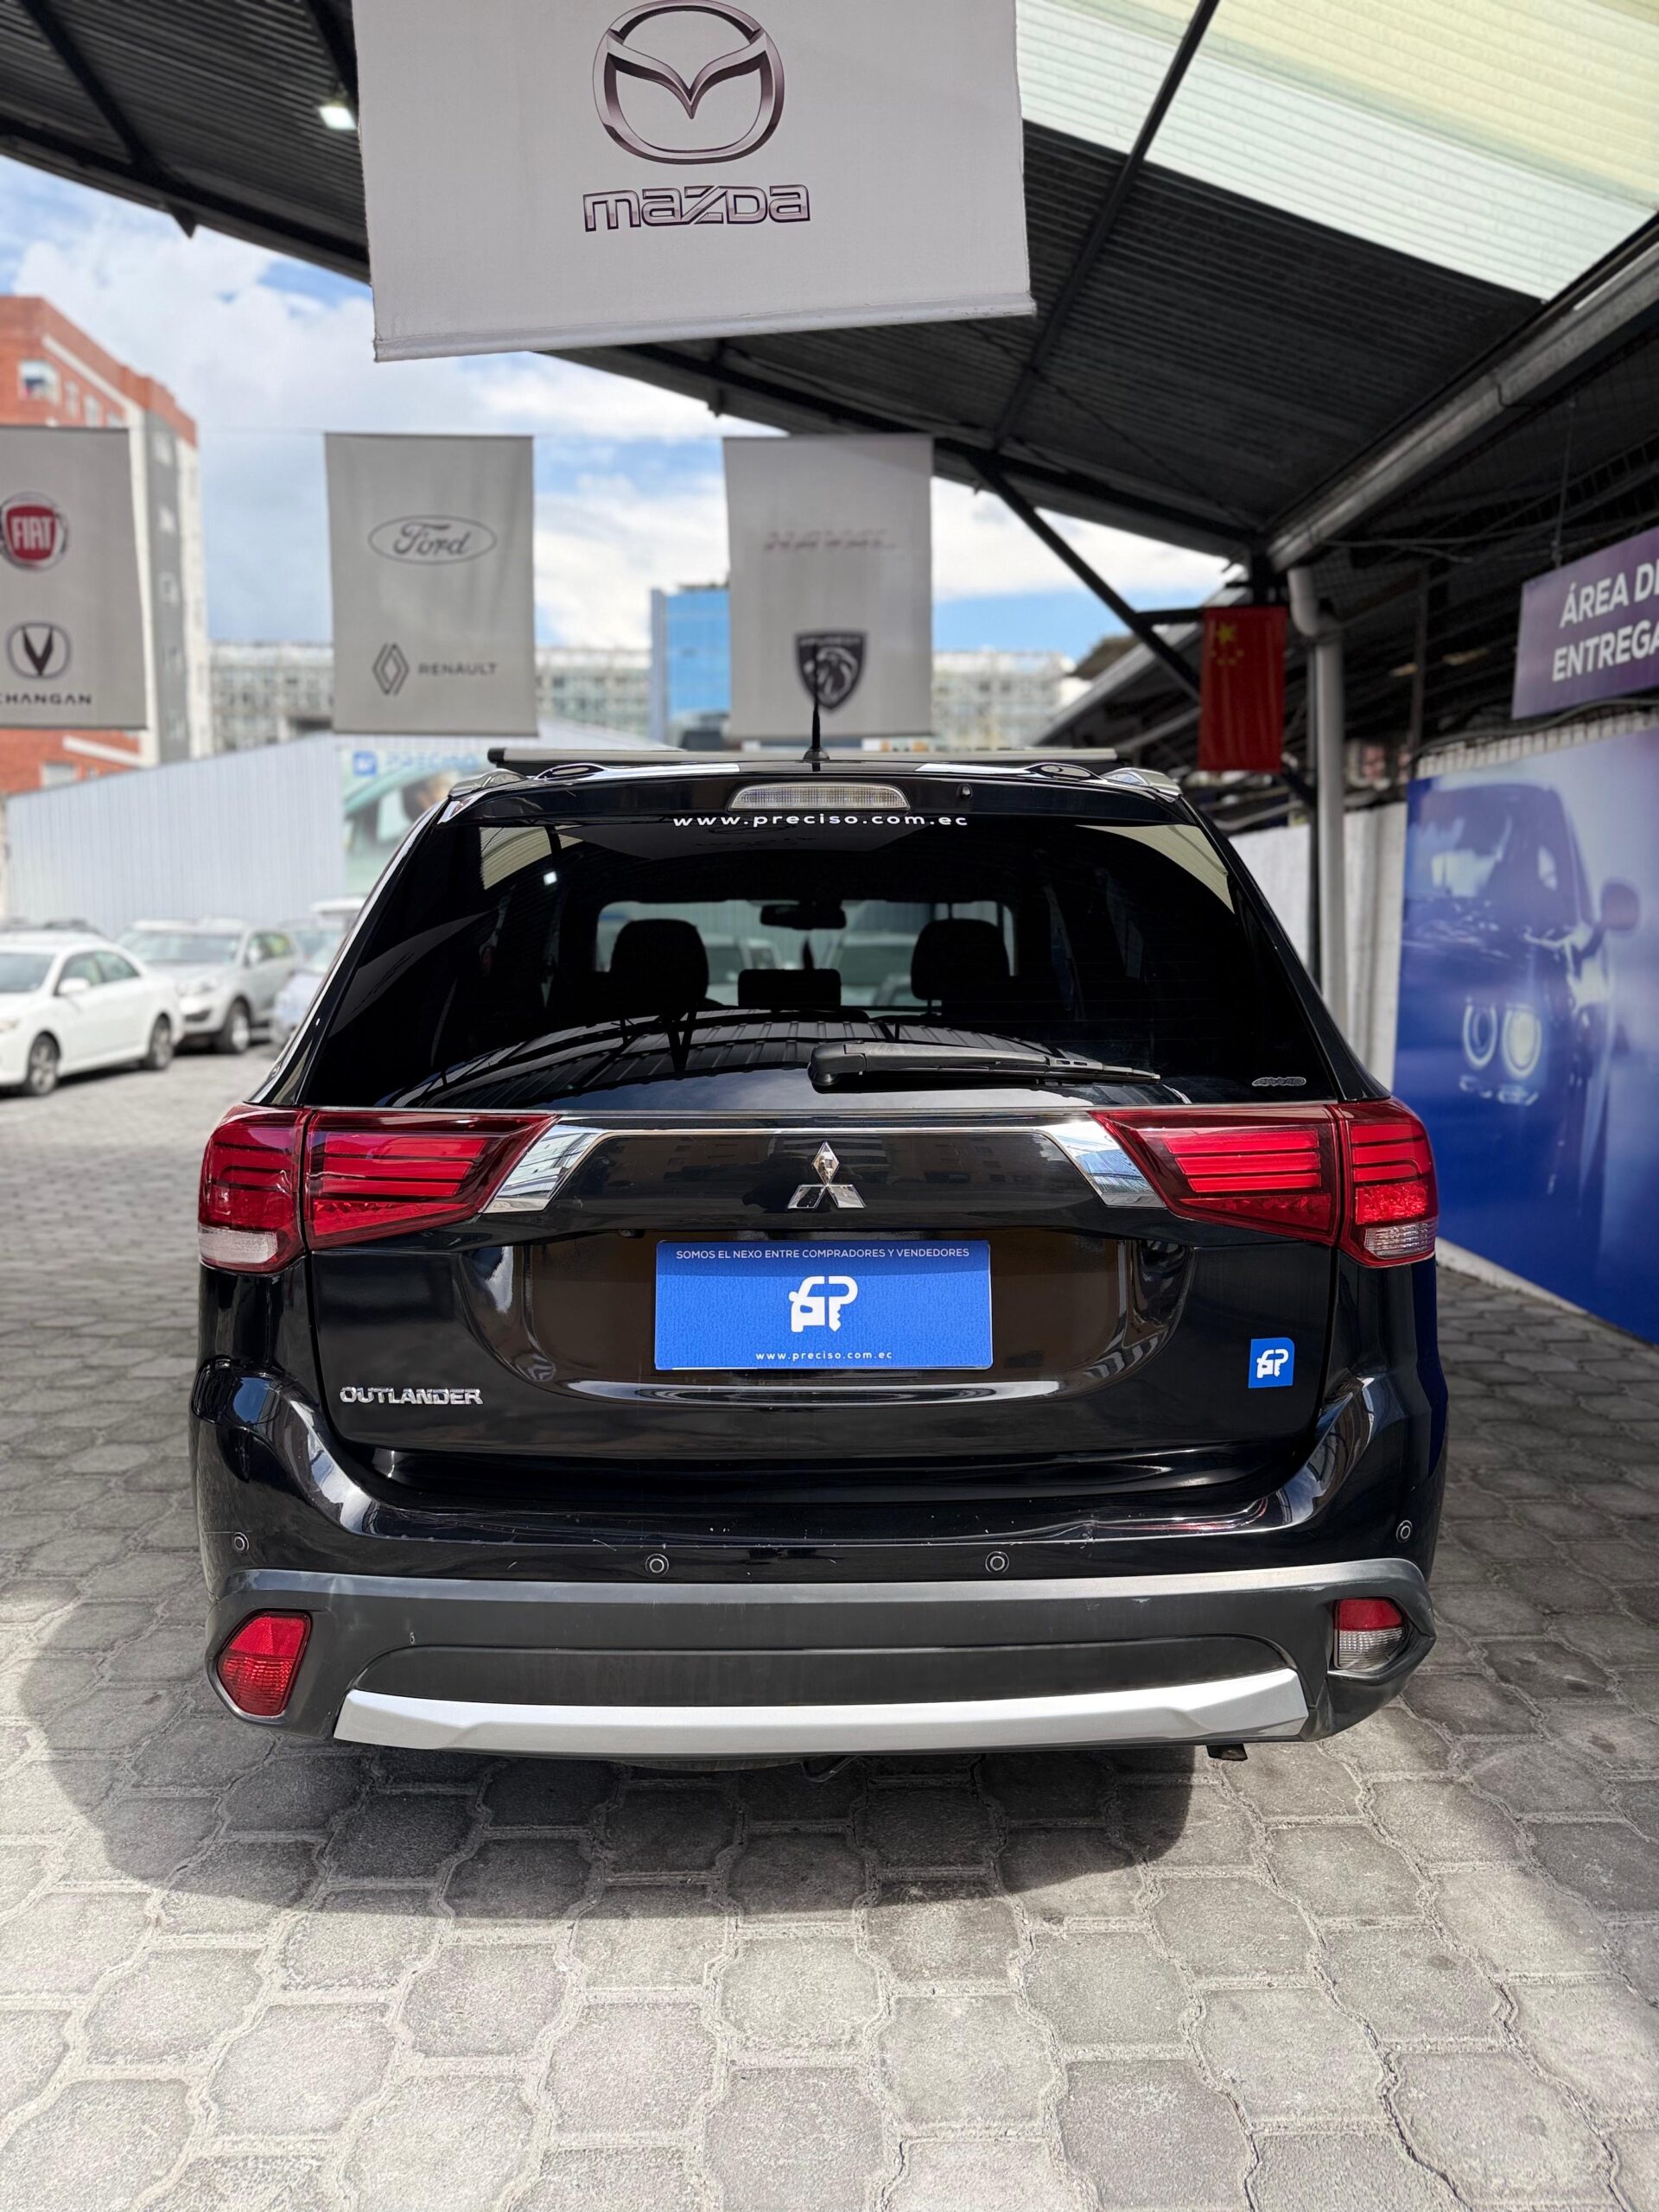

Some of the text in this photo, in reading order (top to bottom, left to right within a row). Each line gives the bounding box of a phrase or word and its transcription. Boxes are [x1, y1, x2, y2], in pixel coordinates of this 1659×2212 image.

[11, 516, 53, 550] FIAT
[393, 521, 471, 556] Ford
[1559, 558, 1659, 628] ÁREA D
[418, 661, 498, 677] RENAULT
[0, 693, 92, 706] HANGAN
[672, 813, 969, 828] www.preciso.com.ec
[676, 1248, 969, 1260] SOMOS EL NEXO ENTRE COMPRADORES Y VENDEDORES
[755, 1351, 893, 1362] www.preciso.com.ec
[340, 1387, 484, 1405] OUTLANDER
